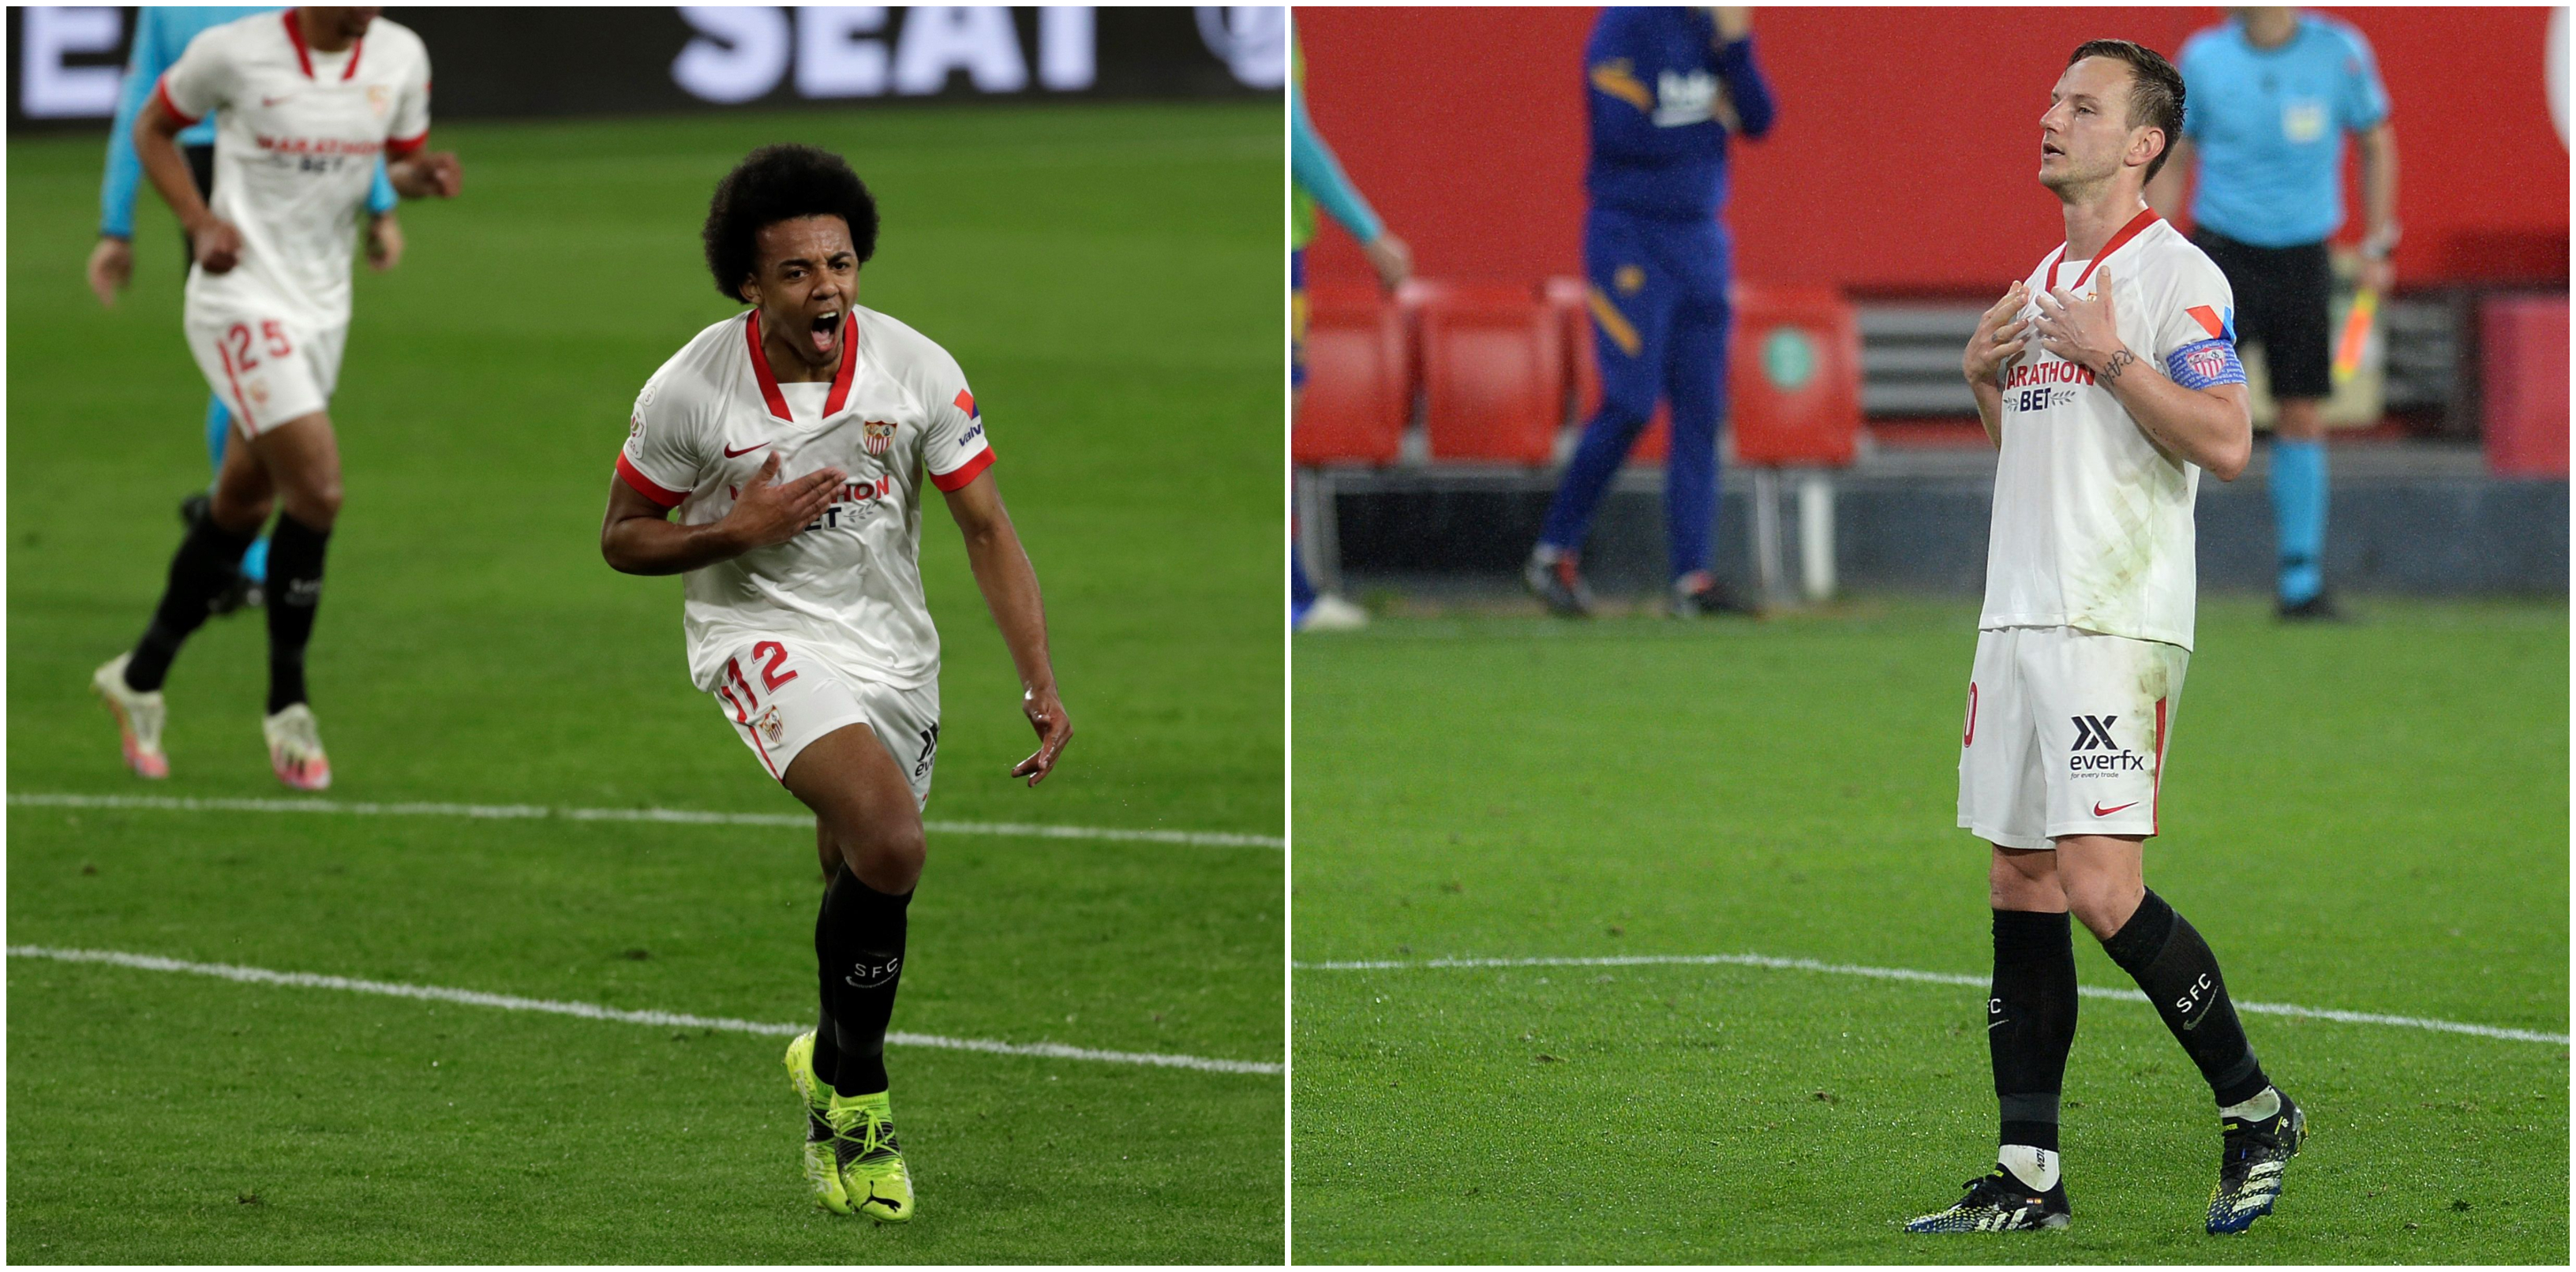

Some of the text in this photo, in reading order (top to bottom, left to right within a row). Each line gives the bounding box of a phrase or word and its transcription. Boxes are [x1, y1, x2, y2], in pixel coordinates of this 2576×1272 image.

[228, 319, 293, 372] 25
[2005, 361, 2095, 390] ARATHON
[2020, 387, 2051, 412] BET
[803, 507, 842, 532] ET
[728, 641, 798, 714] 12
[2070, 749, 2144, 770] everfx
[854, 957, 898, 978] SFC
[2176, 973, 2211, 1013] SFC
[1986, 998, 2001, 1014] C
